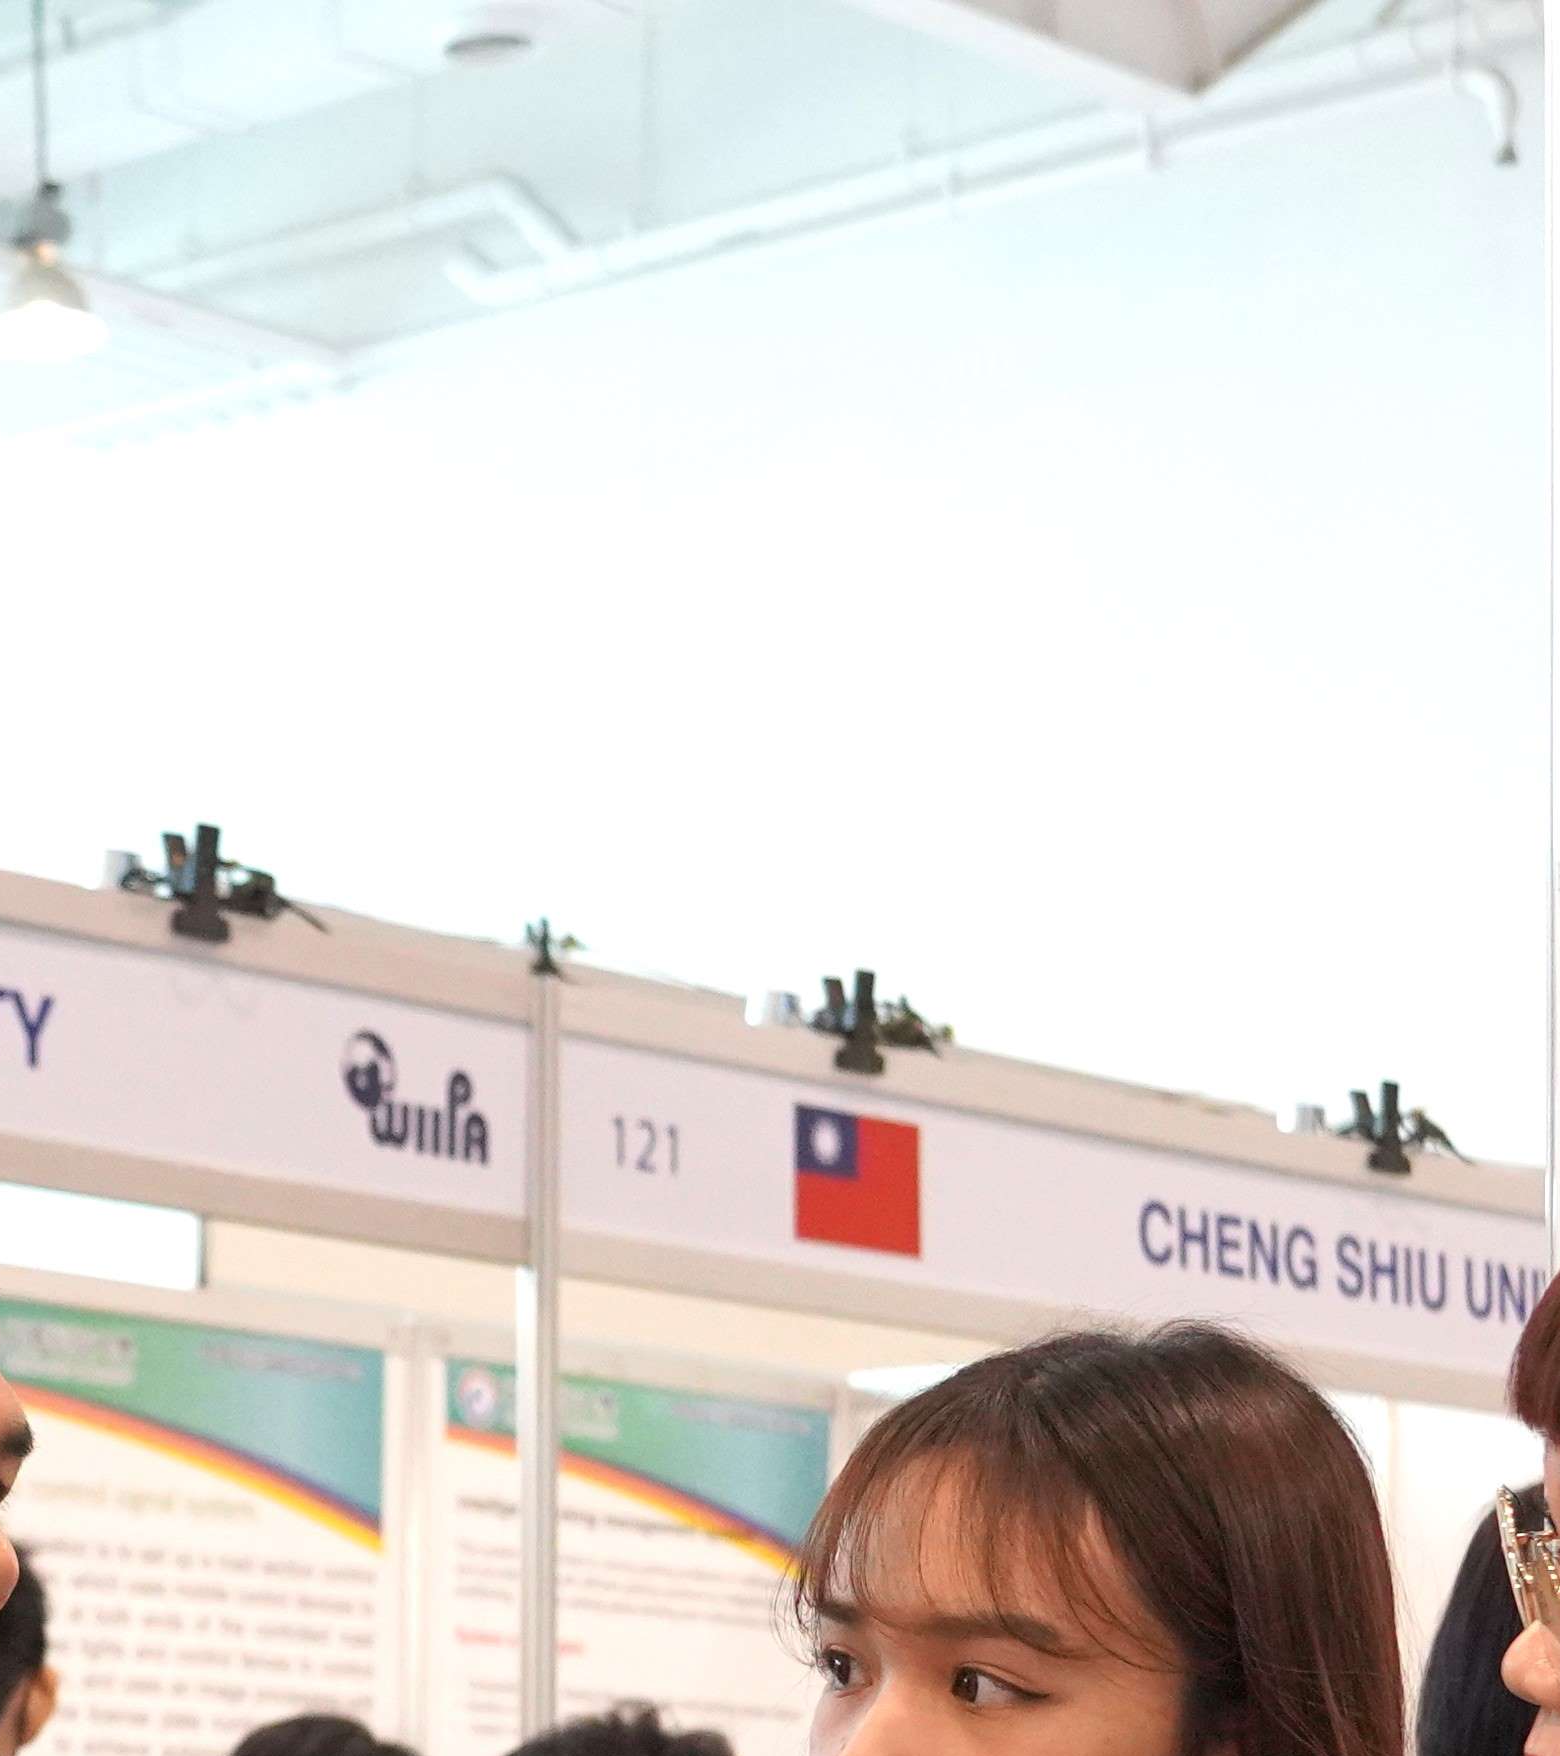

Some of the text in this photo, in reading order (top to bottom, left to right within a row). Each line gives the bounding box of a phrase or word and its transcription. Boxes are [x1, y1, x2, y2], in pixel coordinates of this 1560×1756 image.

[612, 1116, 680, 1177] 121
[1139, 1200, 1547, 1323] CHENG SHIU UNI
